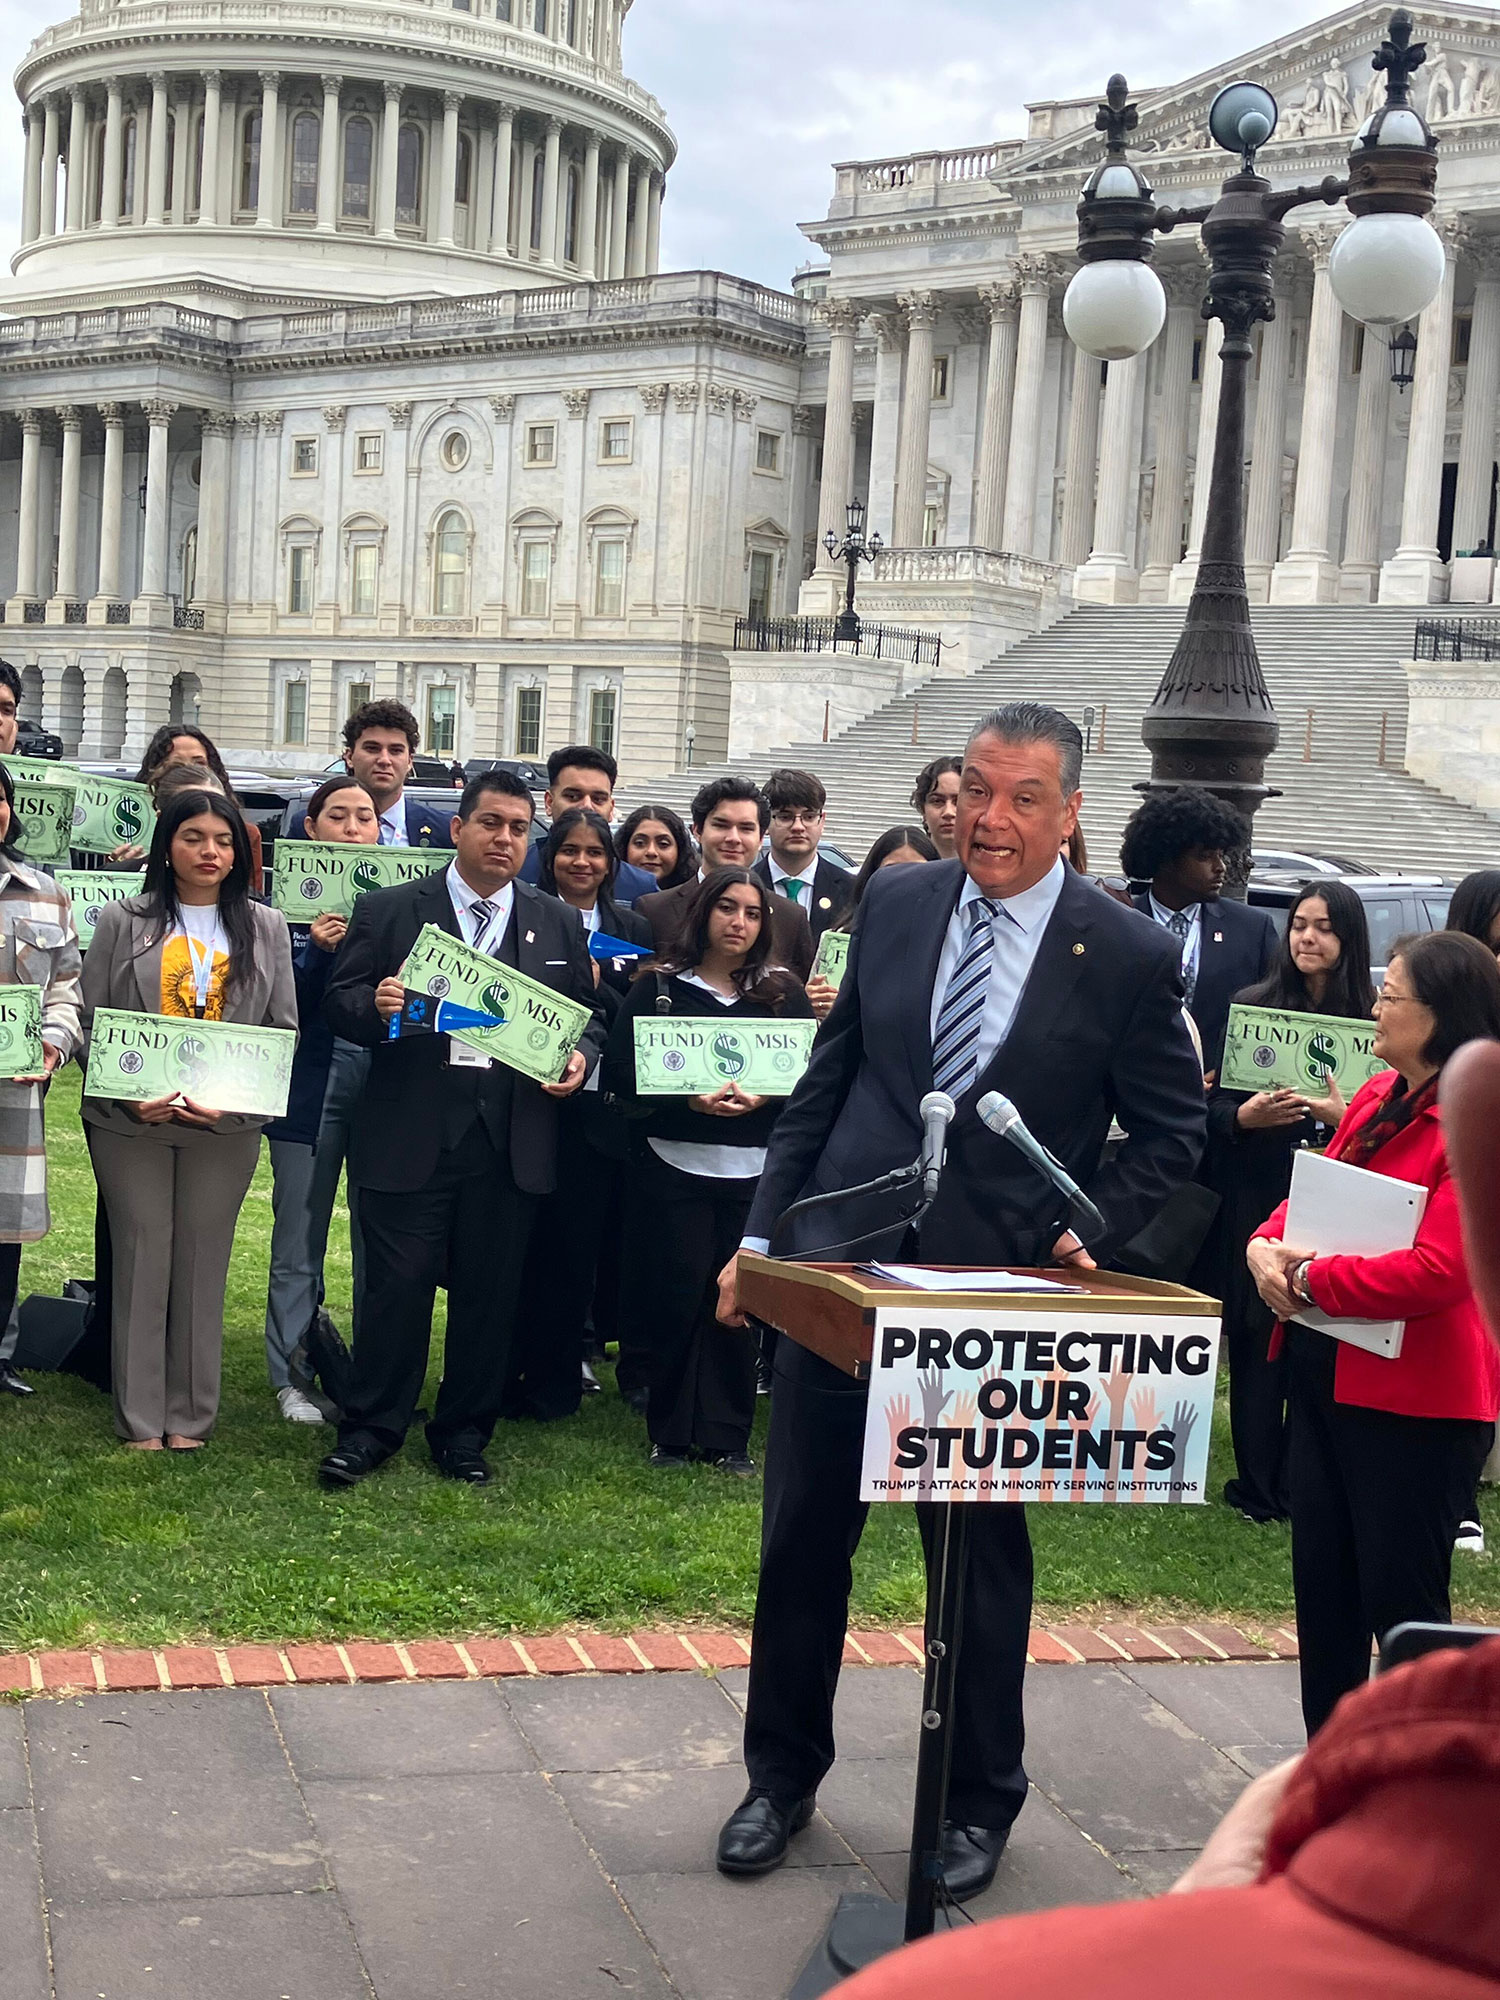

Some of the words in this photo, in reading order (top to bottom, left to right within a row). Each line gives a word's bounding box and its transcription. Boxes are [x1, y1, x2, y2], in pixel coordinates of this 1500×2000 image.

[77, 789, 109, 807] ND
[287, 856, 344, 875] FUND
[70, 887, 126, 902] FUND
[425, 947, 480, 985] FUND
[521, 998, 564, 1032] MSIs
[107, 1027, 169, 1051] FUND
[225, 1040, 271, 1062] MSIs
[648, 1032, 704, 1048] FUND
[754, 1034, 798, 1049] MSIs
[1242, 1023, 1299, 1045] FUND
[880, 1327, 1212, 1376] PROTECTING
[977, 1377, 1092, 1421] OUR
[894, 1426, 1177, 1471] STUDENTS
[872, 1479, 926, 1490] TRUMP'S
[928, 1480, 977, 1490] ATTACK
[980, 1480, 999, 1490] ON
[1001, 1480, 1060, 1490] MINORITY
[1063, 1480, 1116, 1491] SERVING
[1118, 1481, 1198, 1491] INSTITUTIONS
